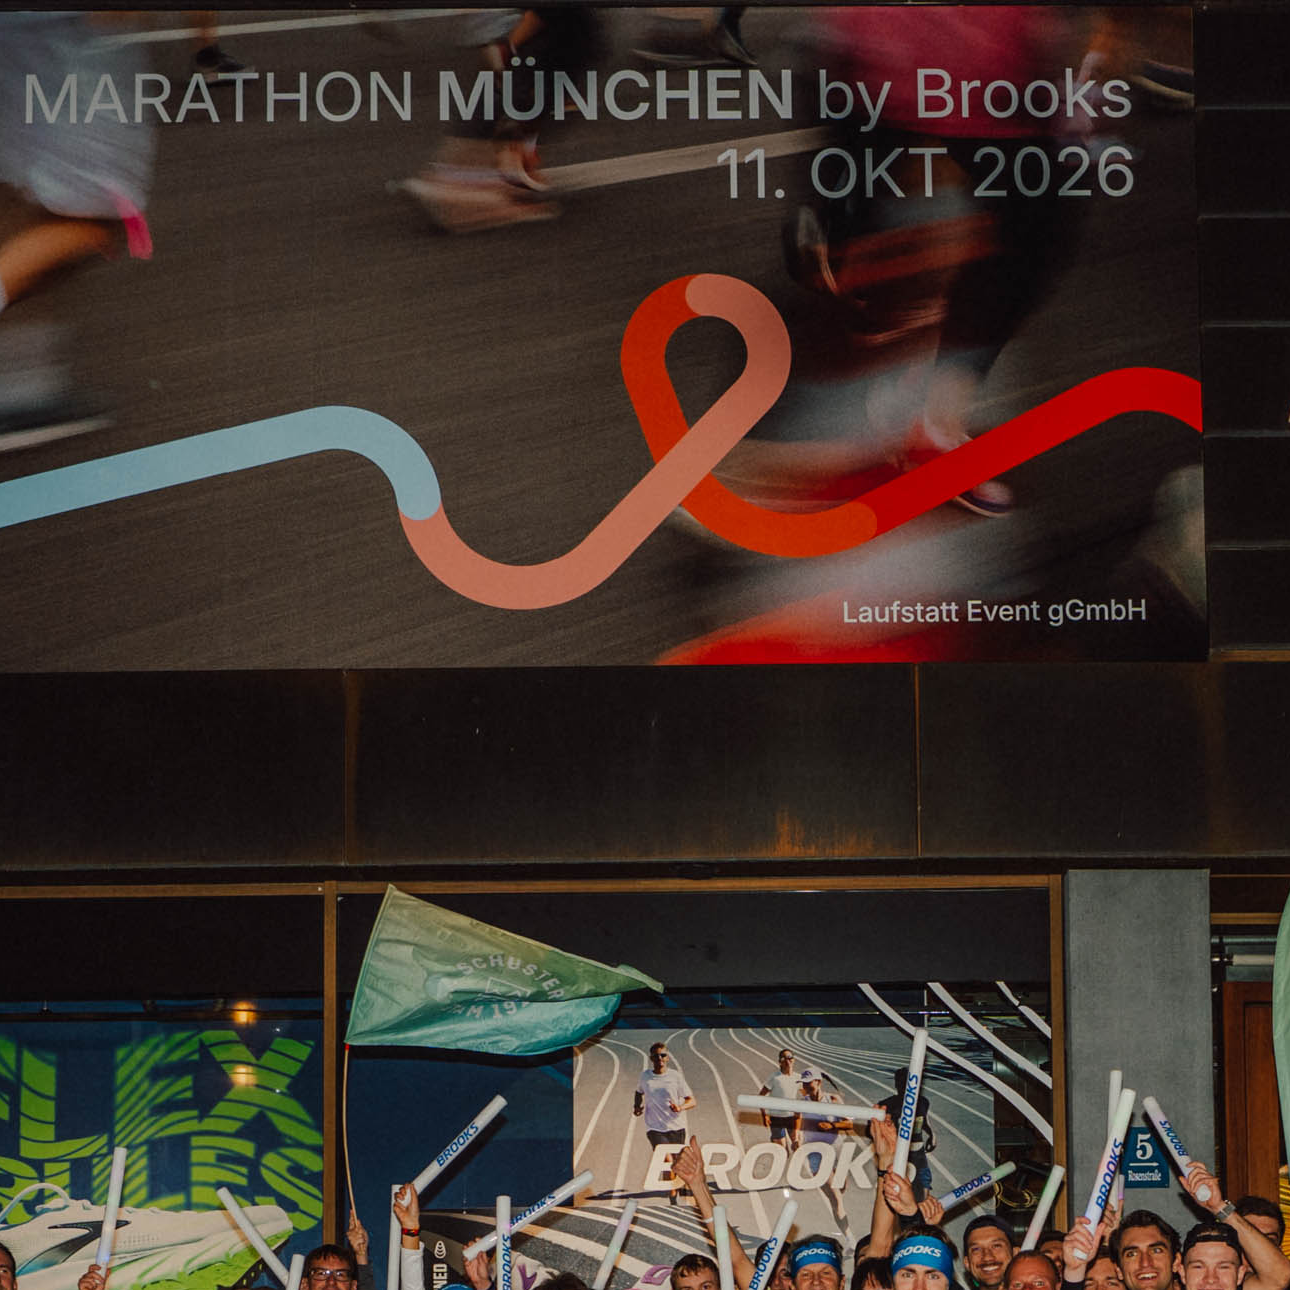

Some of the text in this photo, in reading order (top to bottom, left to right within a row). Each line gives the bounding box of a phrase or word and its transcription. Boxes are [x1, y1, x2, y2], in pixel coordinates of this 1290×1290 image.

[24, 57, 1131, 132] MARATHON MÜNCHEN by Brooks
[716, 145, 1134, 199] 11. OKT 2026
[843, 598, 1146, 627] Laufstatt Event gGmbH
[456, 951, 565, 1000] SCHUSTER
[899, 1073, 918, 1141] BROOKS
[436, 1122, 479, 1168] BROOKS
[643, 1141, 916, 1190] BROOK
[1136, 1133, 1154, 1160] 5
[952, 1172, 993, 1199] BROOKS
[1095, 1138, 1123, 1209] BROOKS
